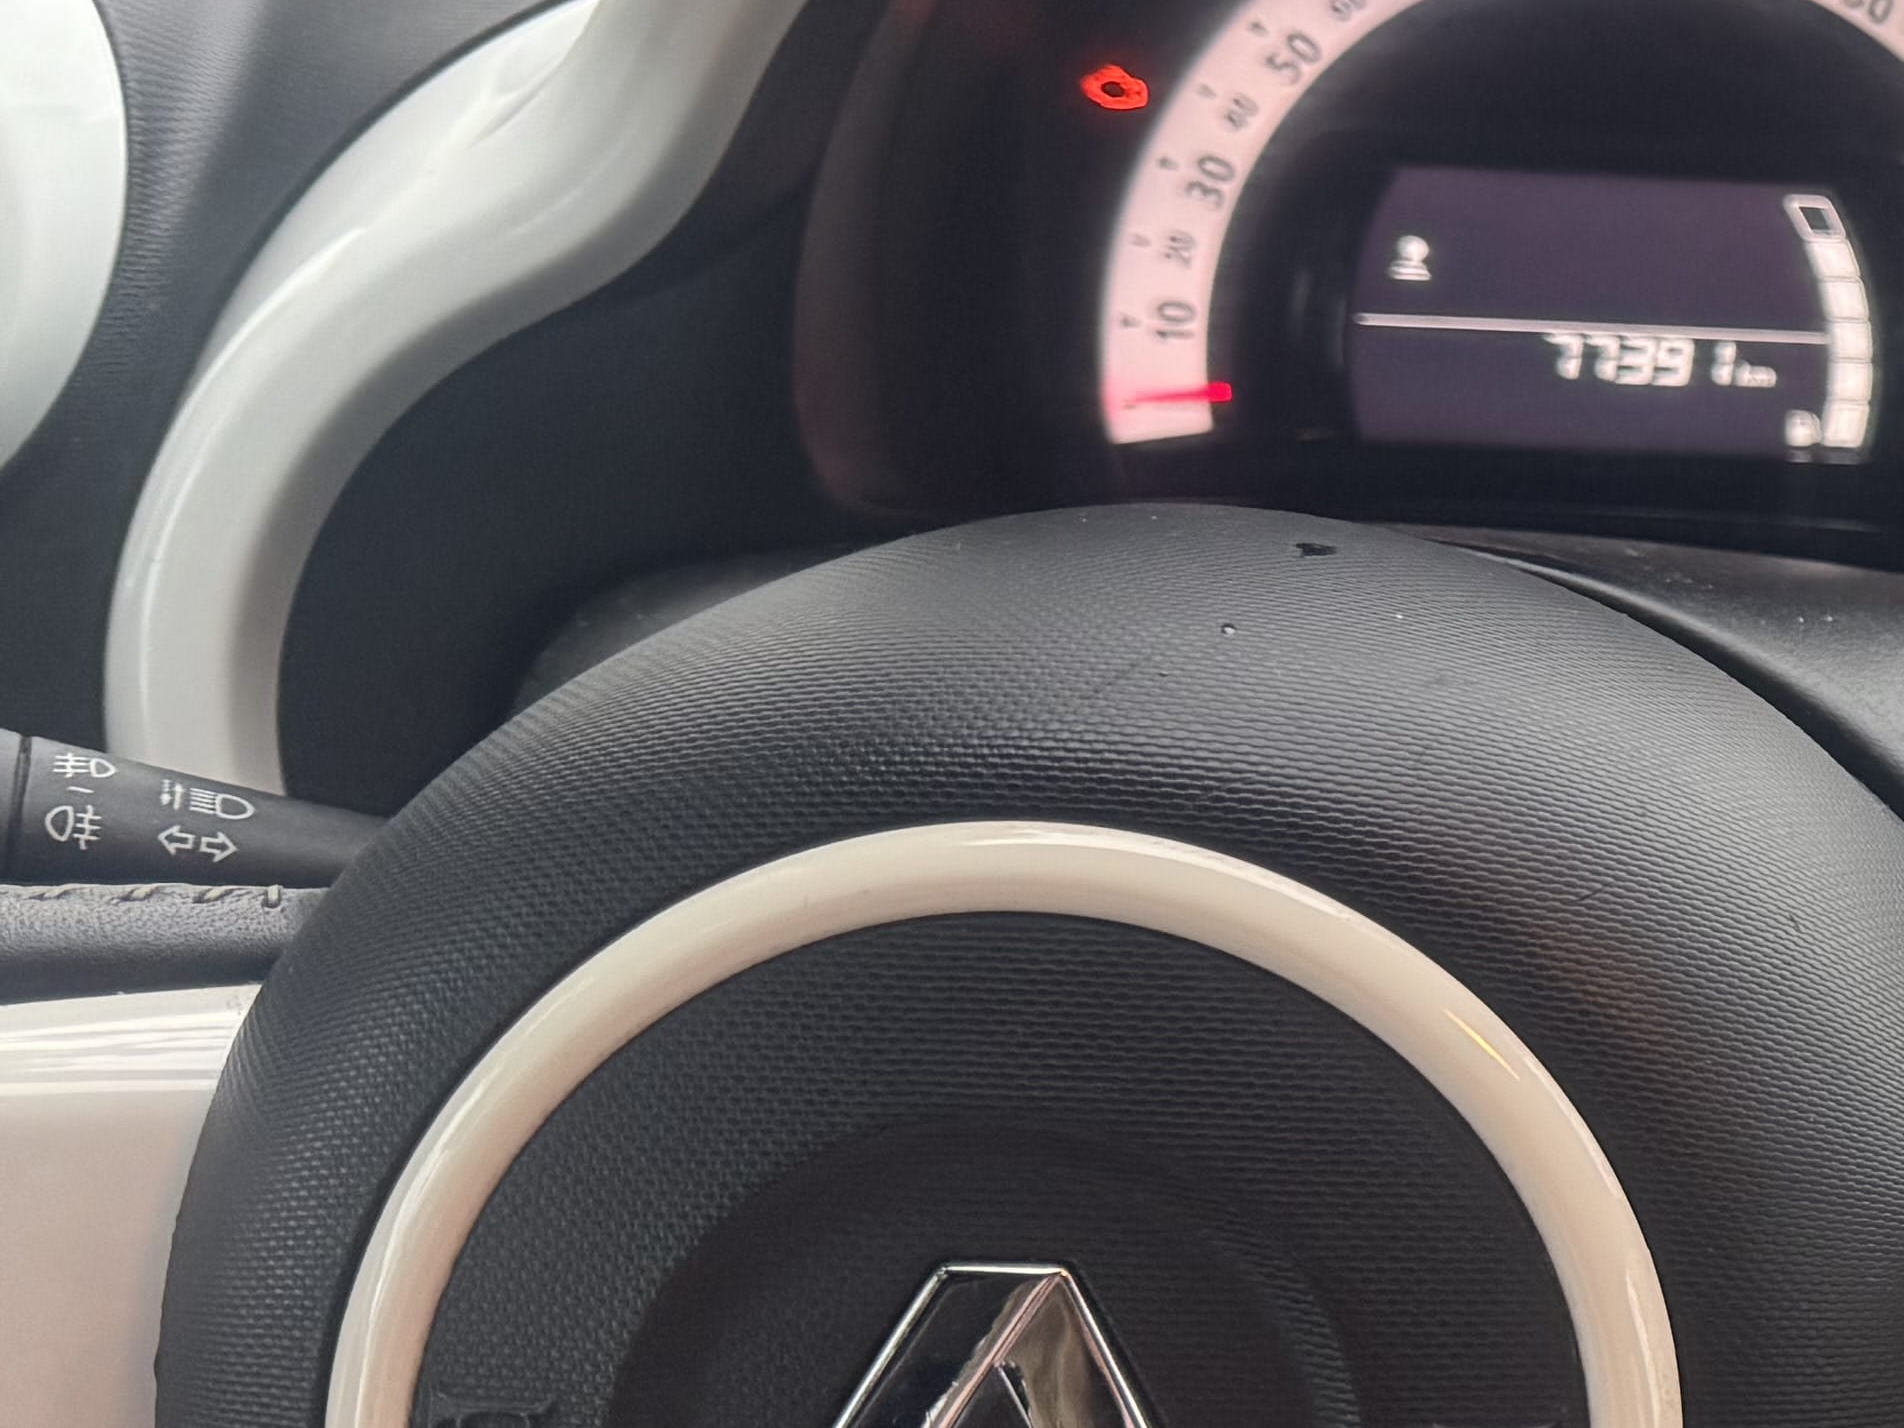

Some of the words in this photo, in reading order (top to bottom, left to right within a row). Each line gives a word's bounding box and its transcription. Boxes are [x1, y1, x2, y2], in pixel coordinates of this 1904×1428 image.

[1264, 30, 1322, 85] 50
[1184, 155, 1237, 209] 30
[1164, 230, 1197, 269] 20
[1154, 301, 1197, 340] 10
[1544, 332, 1737, 386] 77391
